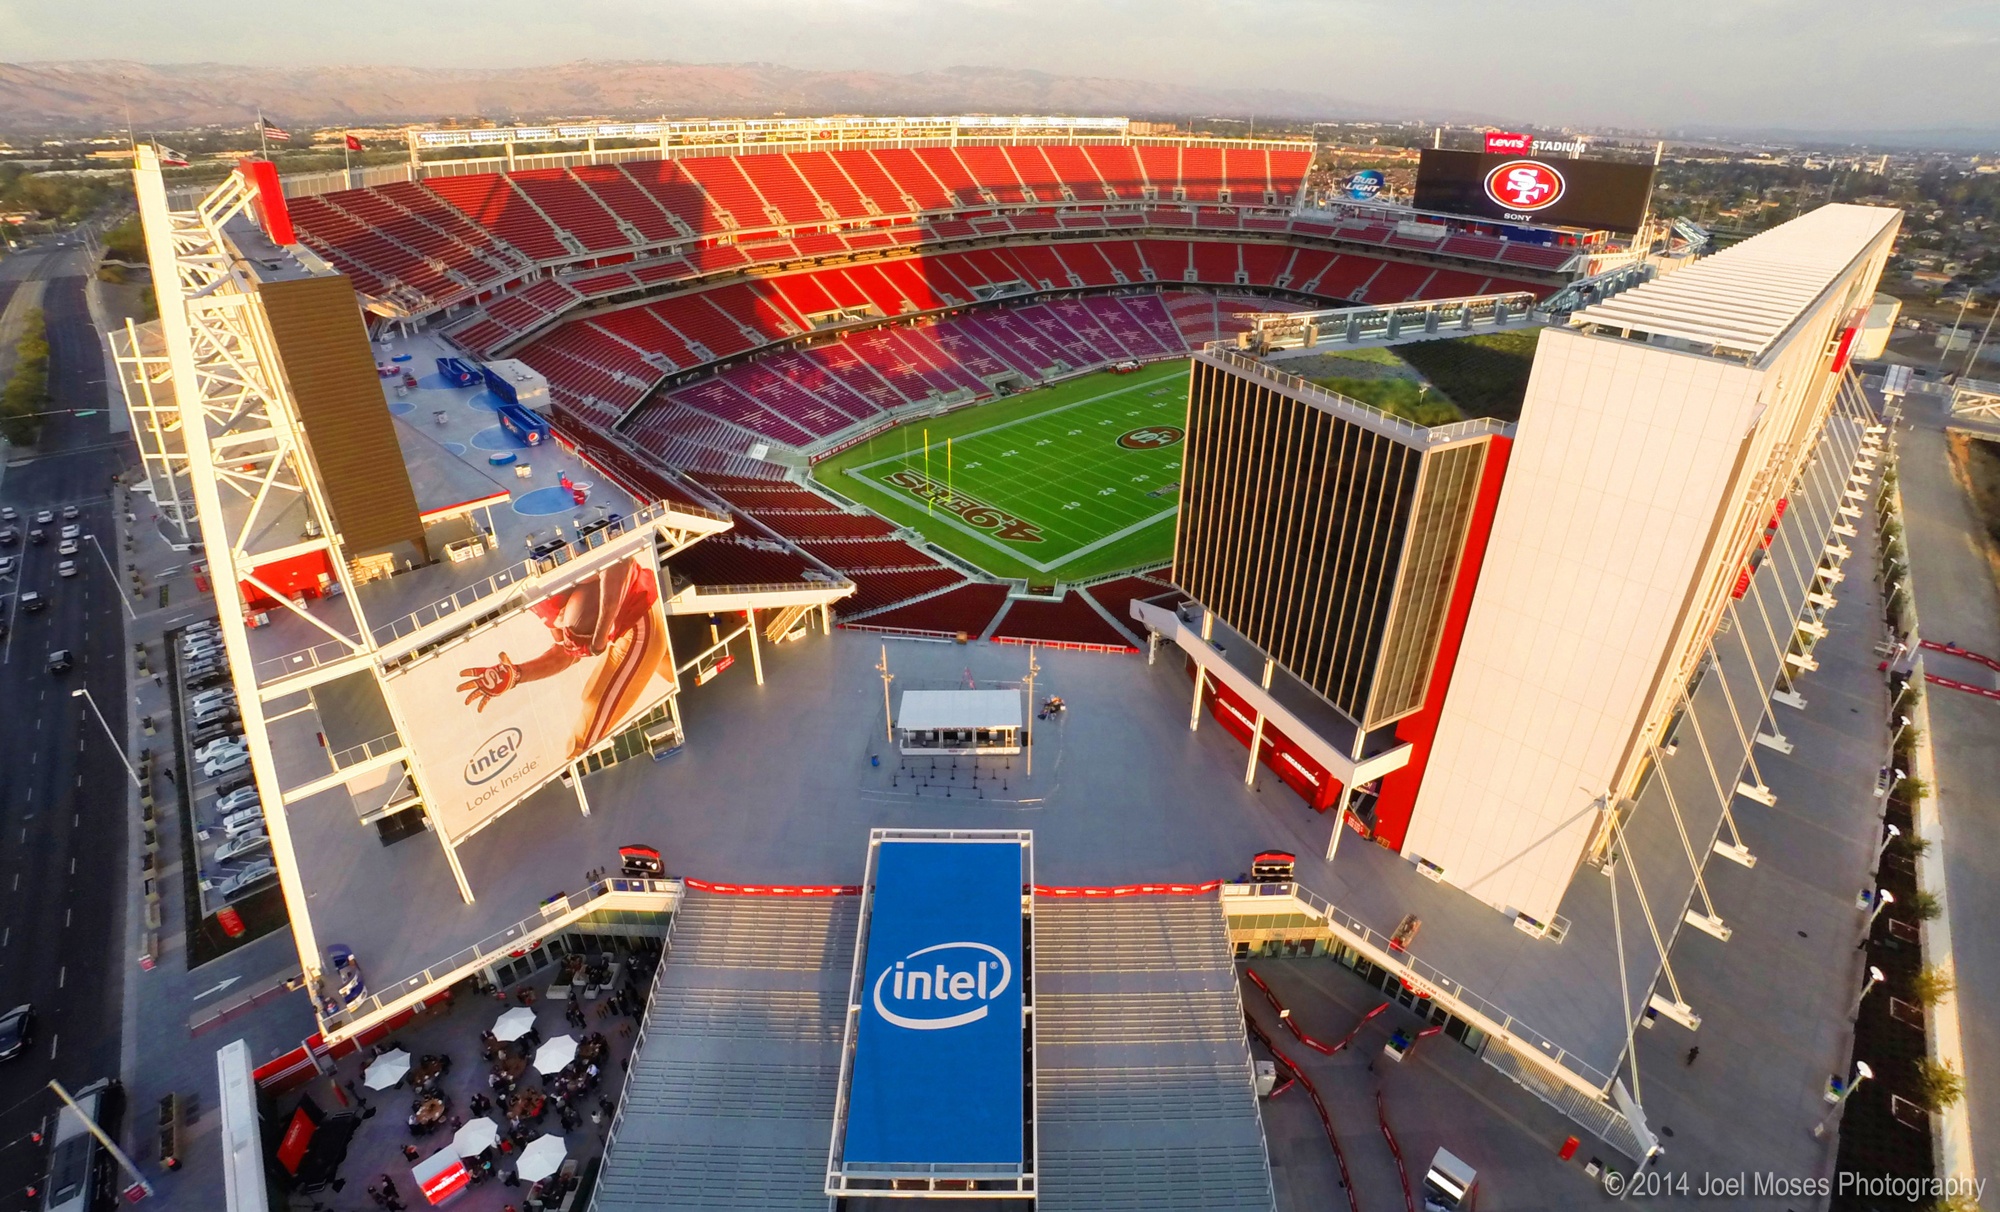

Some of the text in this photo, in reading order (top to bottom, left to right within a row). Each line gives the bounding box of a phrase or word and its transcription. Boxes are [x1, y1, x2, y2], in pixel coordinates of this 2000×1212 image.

[1531, 140, 1587, 153] STADIUM
[1345, 182, 1380, 192] LIGHT
[1352, 175, 1378, 185] BUD
[1503, 213, 1532, 222] SONY
[818, 451, 832, 460] HOME
[839, 442, 848, 451] THE
[848, 439, 858, 447] SAN
[857, 428, 881, 442] FRANCISCO
[1061, 501, 1081, 510] 10
[469, 735, 515, 775] intel
[465, 785, 499, 811] Look
[893, 961, 987, 1001] intel
[1399, 970, 1456, 1006] 49ERS TEAM STORE
